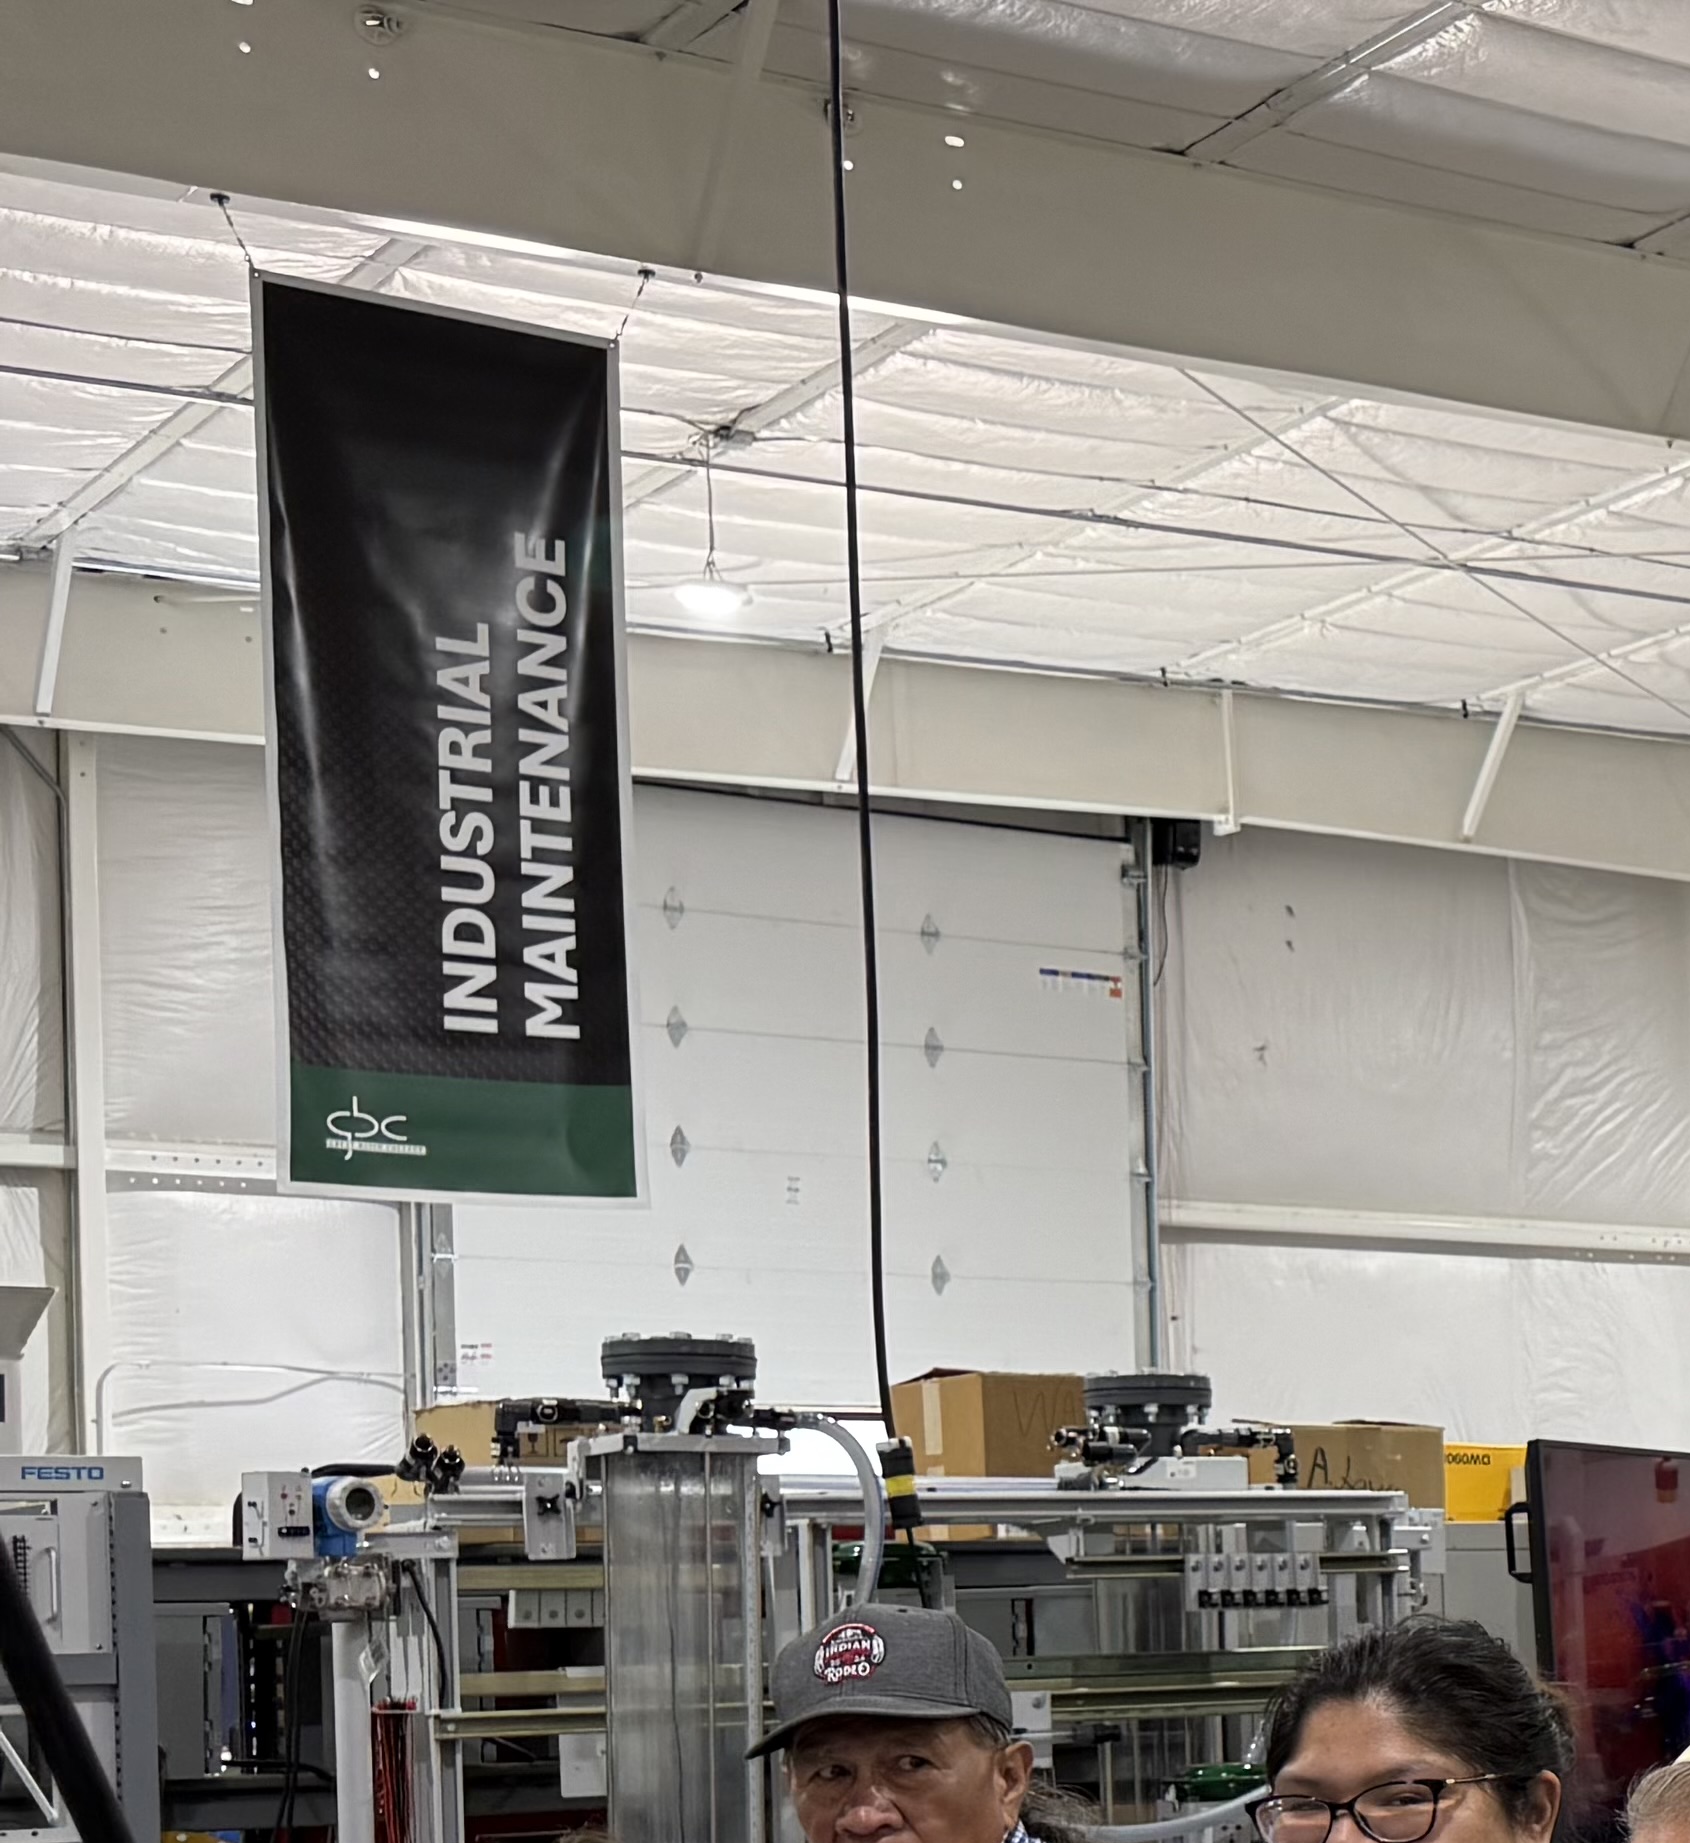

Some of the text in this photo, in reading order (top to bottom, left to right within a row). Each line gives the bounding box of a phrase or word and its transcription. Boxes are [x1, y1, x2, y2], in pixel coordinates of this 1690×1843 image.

[514, 532, 581, 1039] MAINTENANCE
[435, 623, 499, 1034] INDUSTRIAL
[21, 1466, 105, 1480] FESTO
[825, 1639, 871, 1658] INDIAN
[824, 1661, 871, 1682] RODEO
